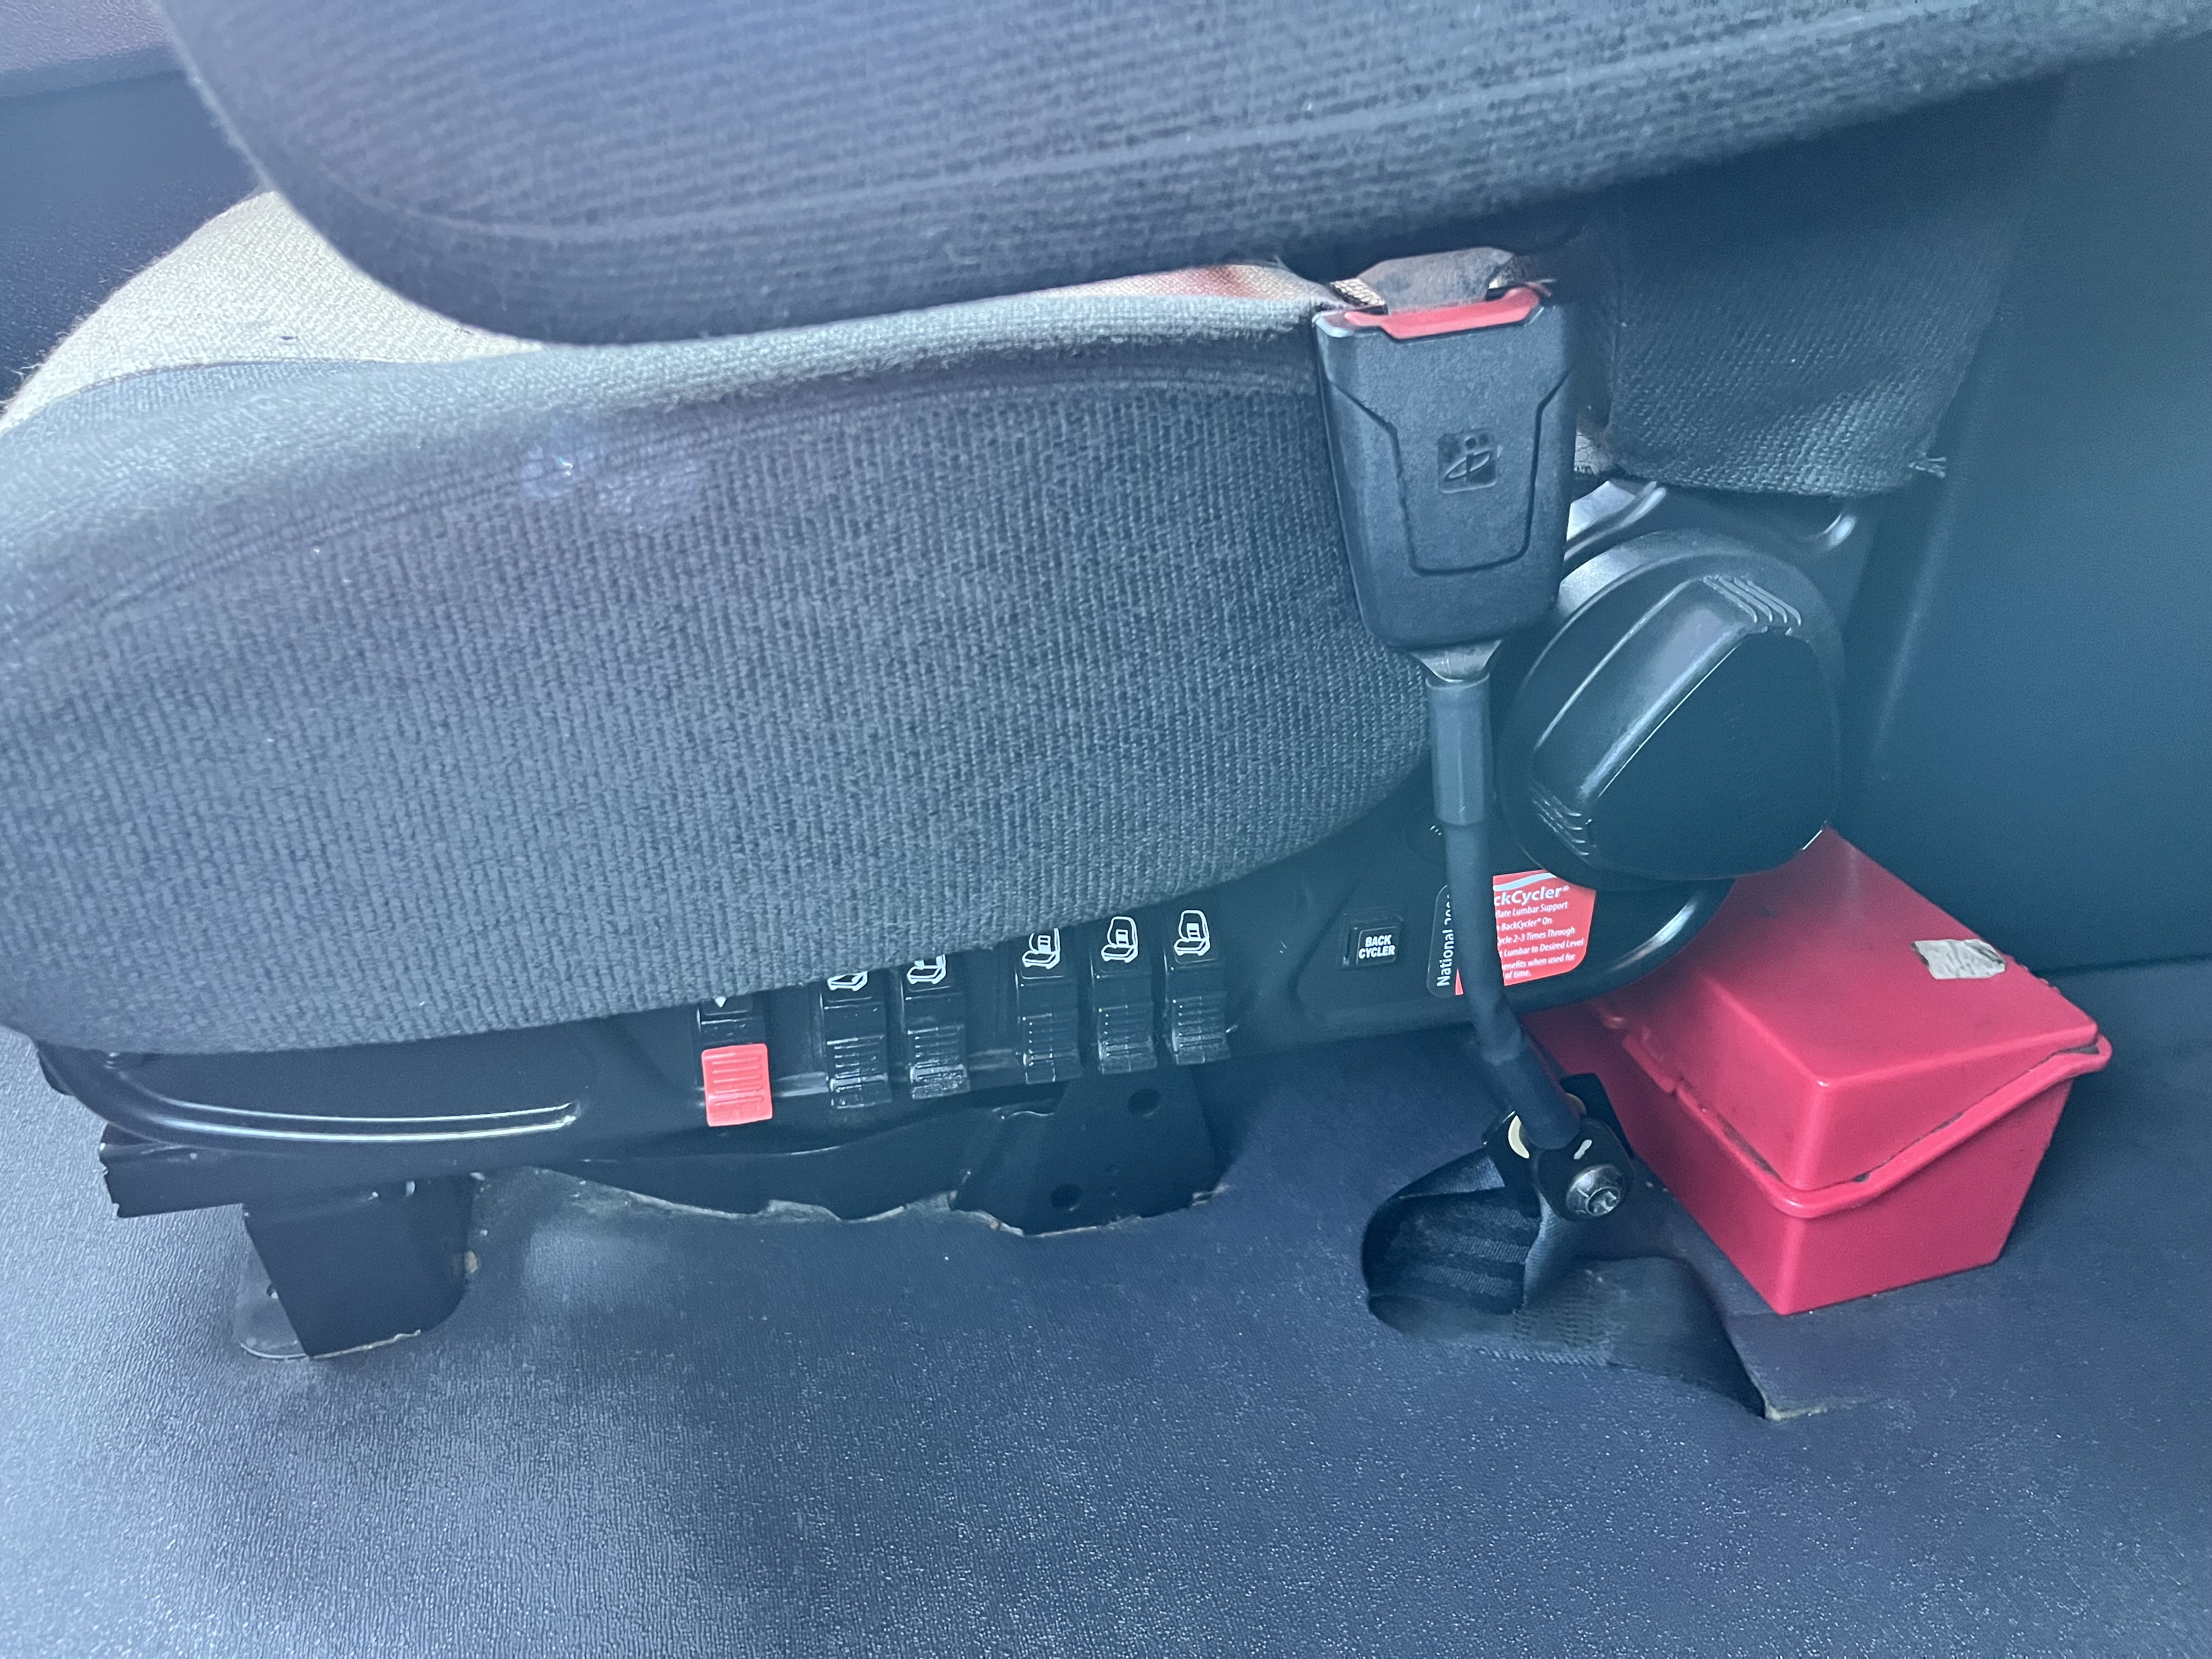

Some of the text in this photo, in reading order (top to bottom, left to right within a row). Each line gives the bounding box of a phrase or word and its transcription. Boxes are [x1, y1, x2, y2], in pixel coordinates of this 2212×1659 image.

[1512, 906, 1539, 916] Lumbar
[1540, 901, 1568, 913] Support
[1542, 916, 1553, 926] On
[1365, 934, 1392, 947] BACK
[1513, 934, 1525, 943] 2-3
[1526, 932, 1547, 941] Times
[1547, 927, 1575, 938] Through
[1358, 945, 1396, 959] CYCLER
[1504, 947, 1531, 957] Lumbar
[1539, 940, 1566, 951] Desired
[1566, 937, 1584, 947] Level
[1436, 929, 1454, 986] National
[1527, 957, 1547, 966] when
[1548, 955, 1565, 964] used
[1565, 952, 1576, 962] for
[1505, 971, 1513, 979] of
